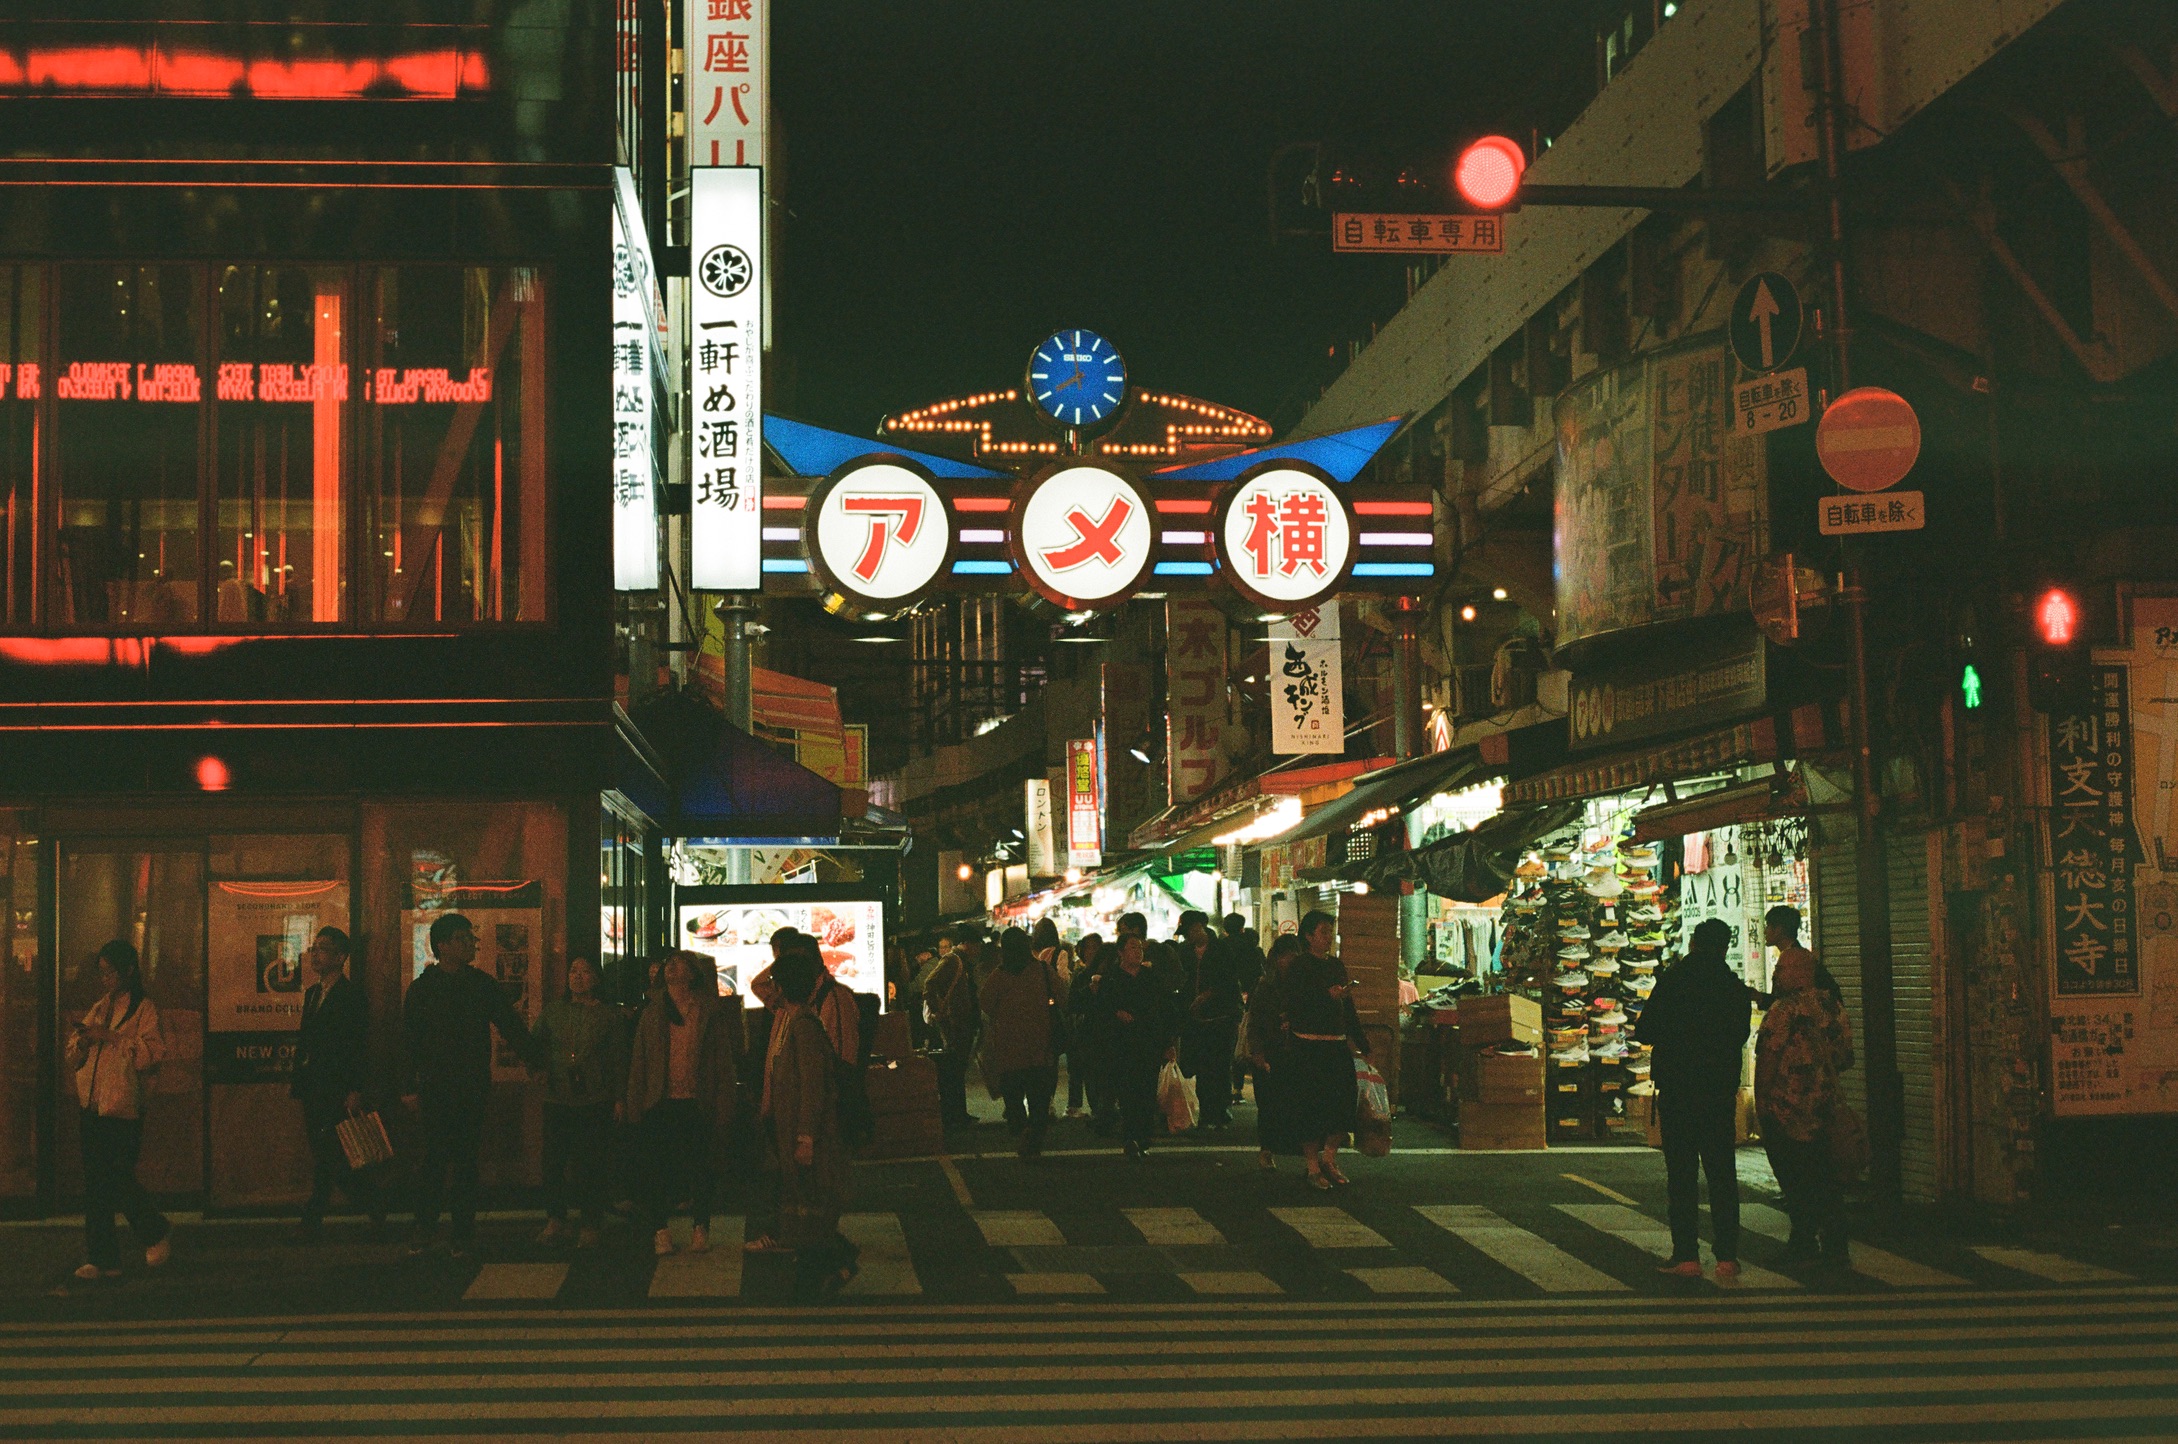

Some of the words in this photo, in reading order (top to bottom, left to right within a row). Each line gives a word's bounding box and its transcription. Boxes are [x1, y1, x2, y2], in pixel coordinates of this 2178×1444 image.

[1345, 217, 1495, 245] 自転車専用
[1063, 354, 1093, 362] SEIKO
[1740, 378, 1801, 408] 自転車を除く
[697, 319, 741, 511] 一軒め酒場
[1827, 500, 1916, 526] 自転車を除く
[841, 488, 1329, 584] アメ横
[1036, 788, 1047, 831] ロントン
[236, 1004, 272, 1014] BRAND
[236, 1046, 273, 1059] NEW
